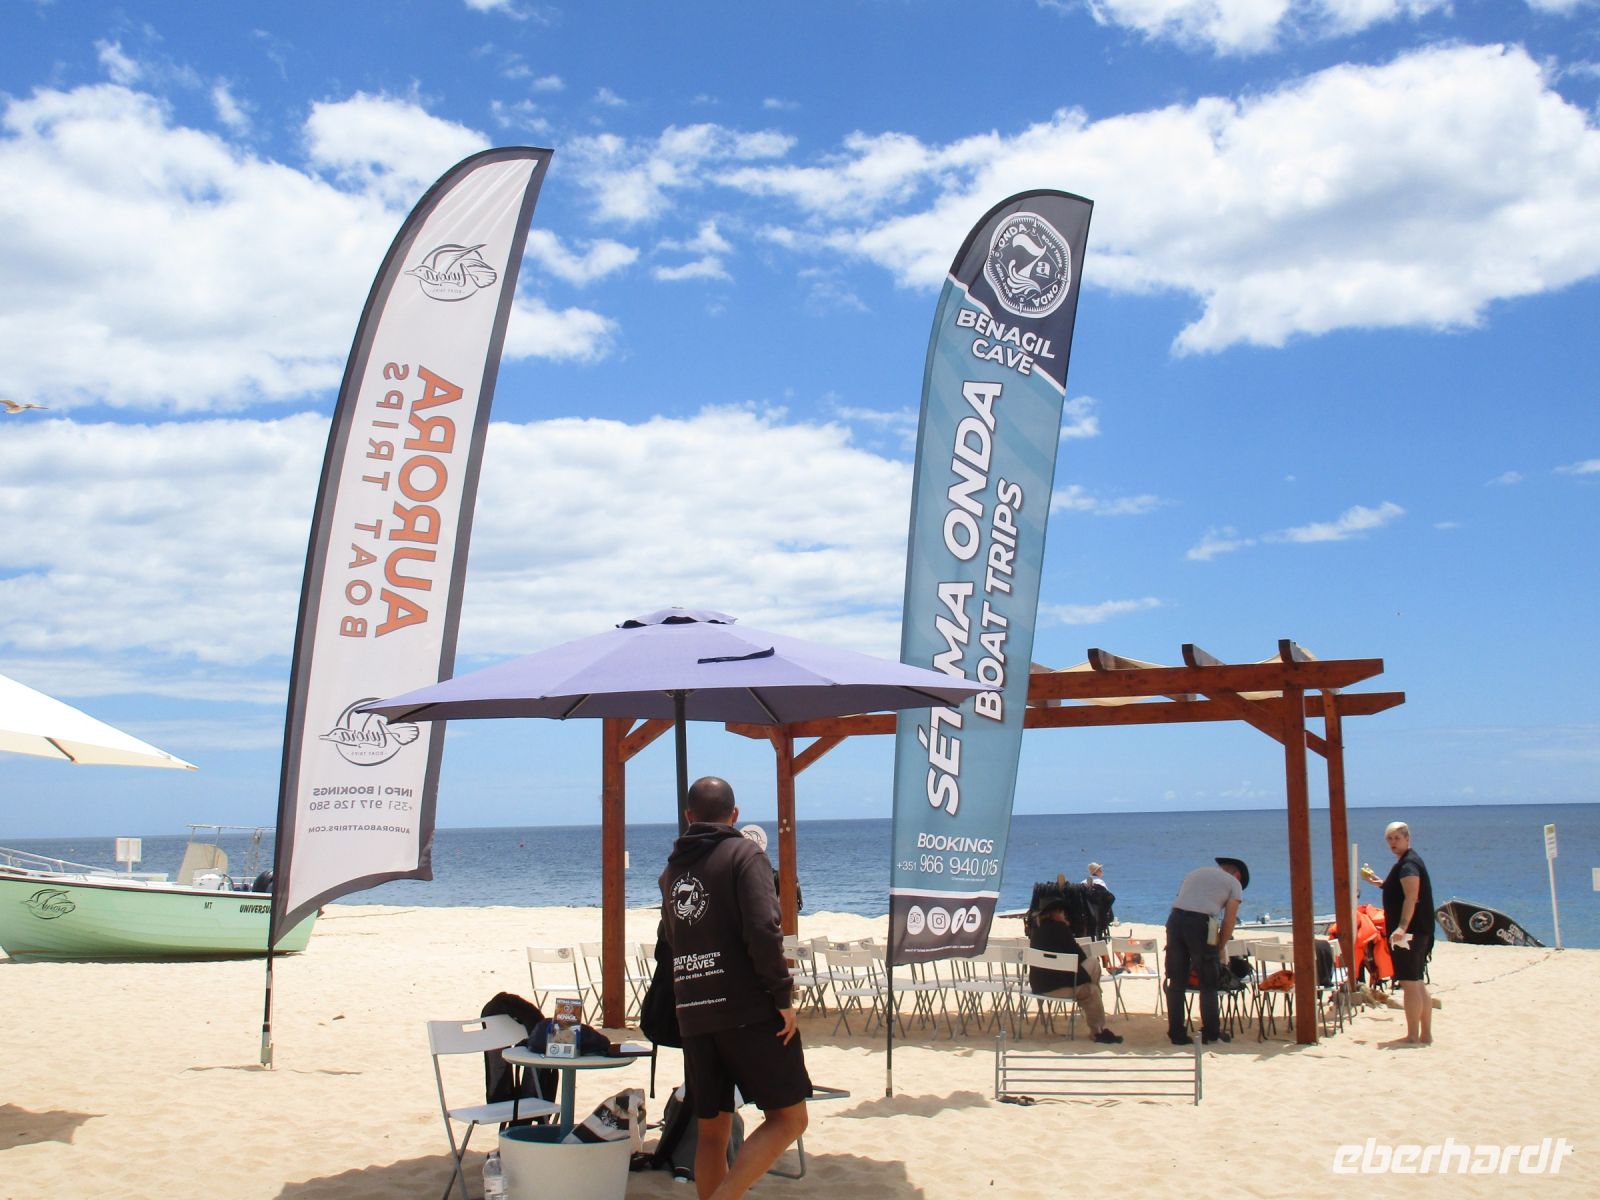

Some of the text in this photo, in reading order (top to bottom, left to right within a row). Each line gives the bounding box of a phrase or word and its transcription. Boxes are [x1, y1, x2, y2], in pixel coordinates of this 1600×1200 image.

[998, 223, 1027, 248] ONDA
[1031, 284, 1059, 307] ONDA
[956, 308, 1056, 359] BENAGIL
[972, 338, 1034, 376] CAVE
[943, 381, 1004, 561] ONDA
[974, 478, 1023, 722] BOAT TRIPS
[918, 581, 974, 816] SÉTMA
[917, 832, 994, 854] BOOKINGS
[896, 854, 999, 877] +351 966 940 015
[686, 958, 716, 972] CAVES
